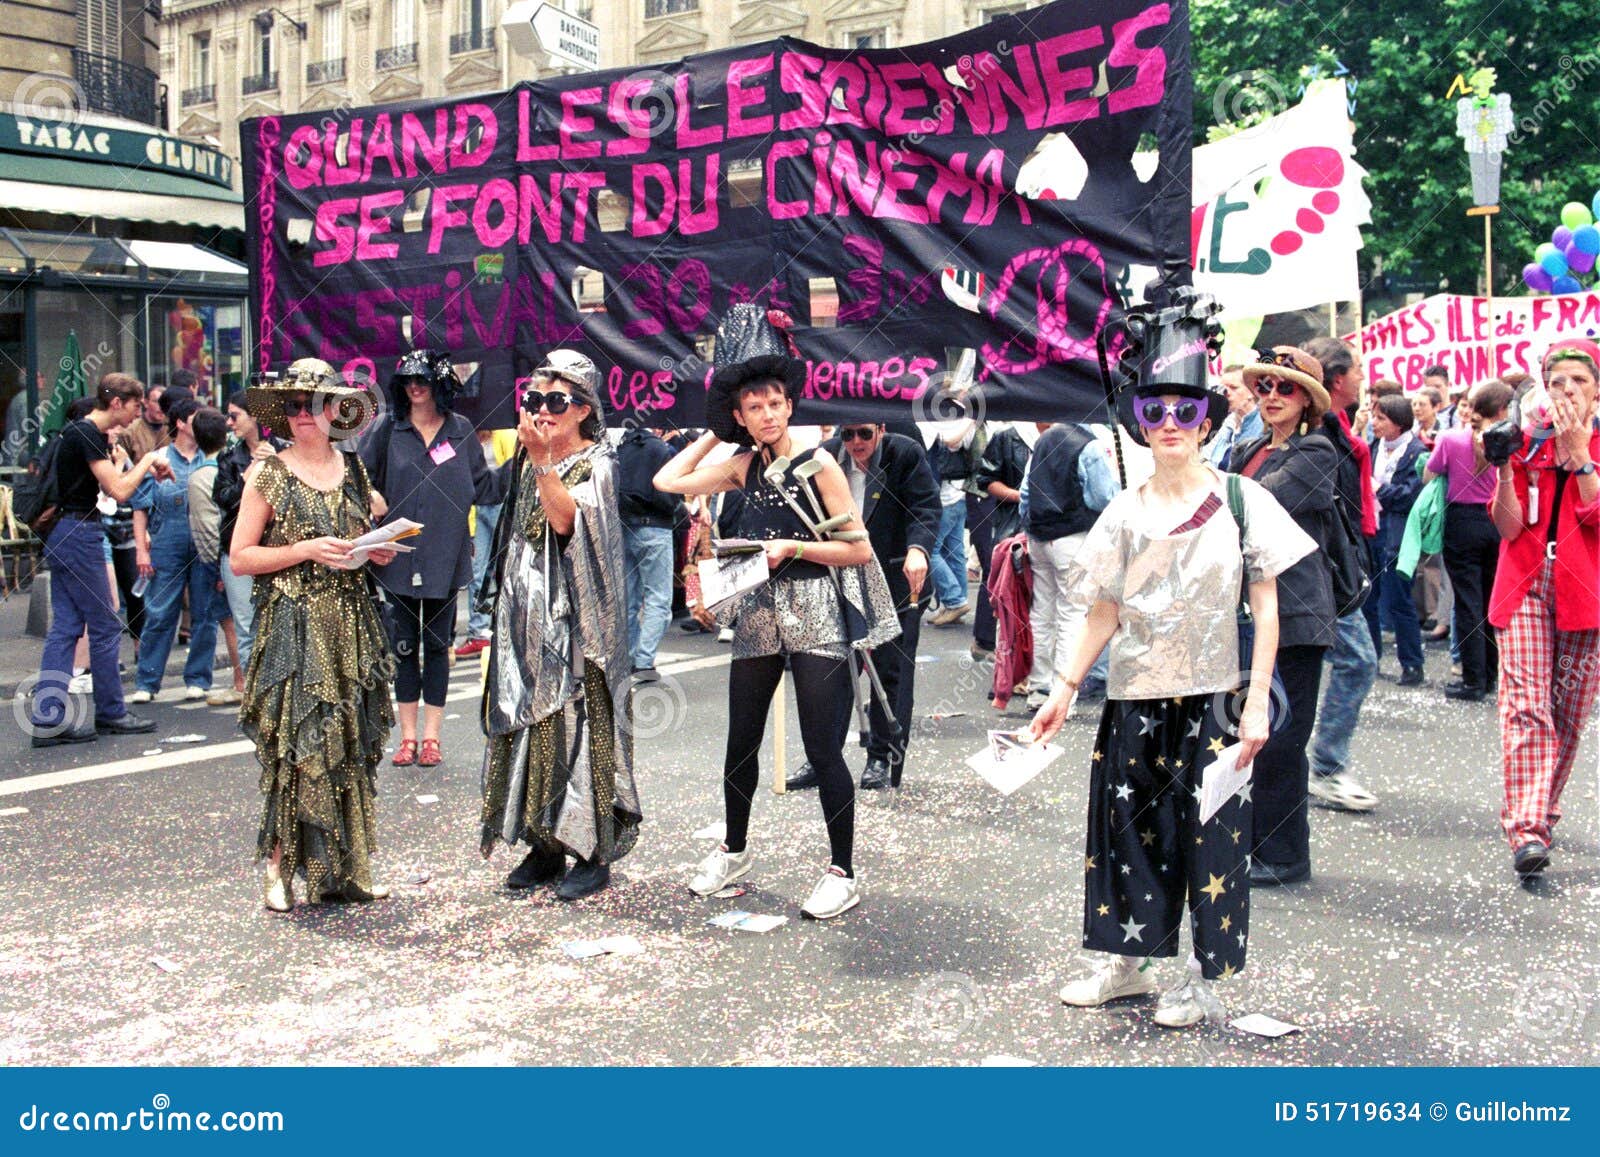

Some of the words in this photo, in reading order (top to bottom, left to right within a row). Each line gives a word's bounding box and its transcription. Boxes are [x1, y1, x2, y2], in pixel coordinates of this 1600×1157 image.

[560, 38, 597, 65] AUSTERLITZ
[561, 19, 597, 47] BASTILLE
[17, 121, 110, 154] TABAC
[146, 138, 216, 177] CLUNY
[284, 103, 499, 189] QUAND
[515, 79, 653, 162] LES
[313, 190, 404, 267] SE
[427, 172, 606, 254] FONT
[632, 153, 720, 238] DU
[620, 257, 713, 339] 30
[1495, 311, 1526, 337] de
[608, 365, 676, 411] les
